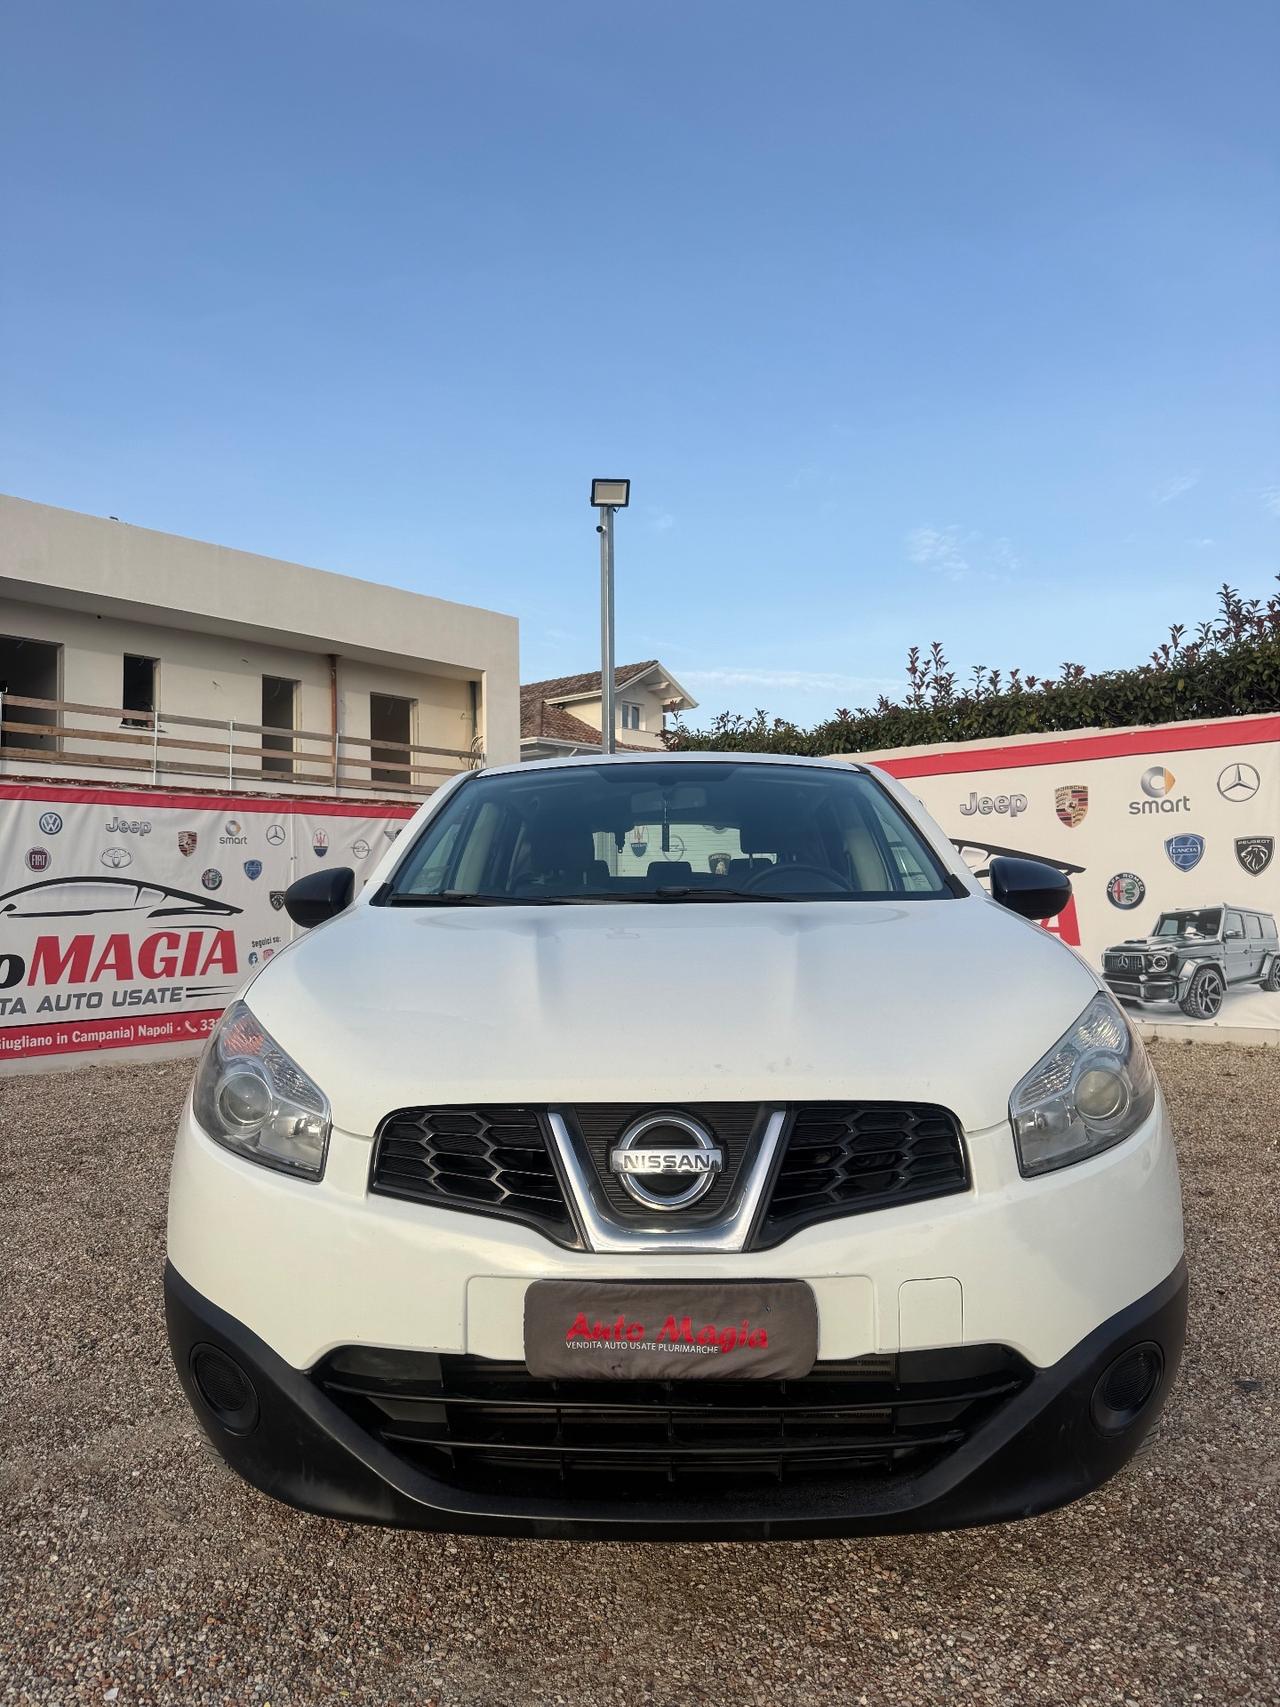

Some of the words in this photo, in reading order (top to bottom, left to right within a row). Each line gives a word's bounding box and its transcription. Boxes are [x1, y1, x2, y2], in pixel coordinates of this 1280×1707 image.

[959, 792, 1028, 818] Jeep
[1129, 797, 1191, 815] smart
[105, 817, 152, 836] Jeep
[219, 836, 247, 845] smart
[31, 854, 47, 866] FIAT
[36, 991, 103, 1013] AUTO
[112, 986, 183, 1007] USATE
[0, 1036, 53, 1050] iugliano
[56, 1032, 68, 1044] in
[72, 1025, 134, 1043] Campania)
[138, 1023, 173, 1038] Napoli
[623, 1154, 711, 1170] NISSAN
[565, 1312, 645, 1342] Auto
[656, 1314, 769, 1354] Magia
[566, 1341, 602, 1349] VENDITA
[604, 1341, 628, 1350] AUTO
[629, 1342, 656, 1351] USATE
[658, 1344, 719, 1354] PLURIMARCHE
